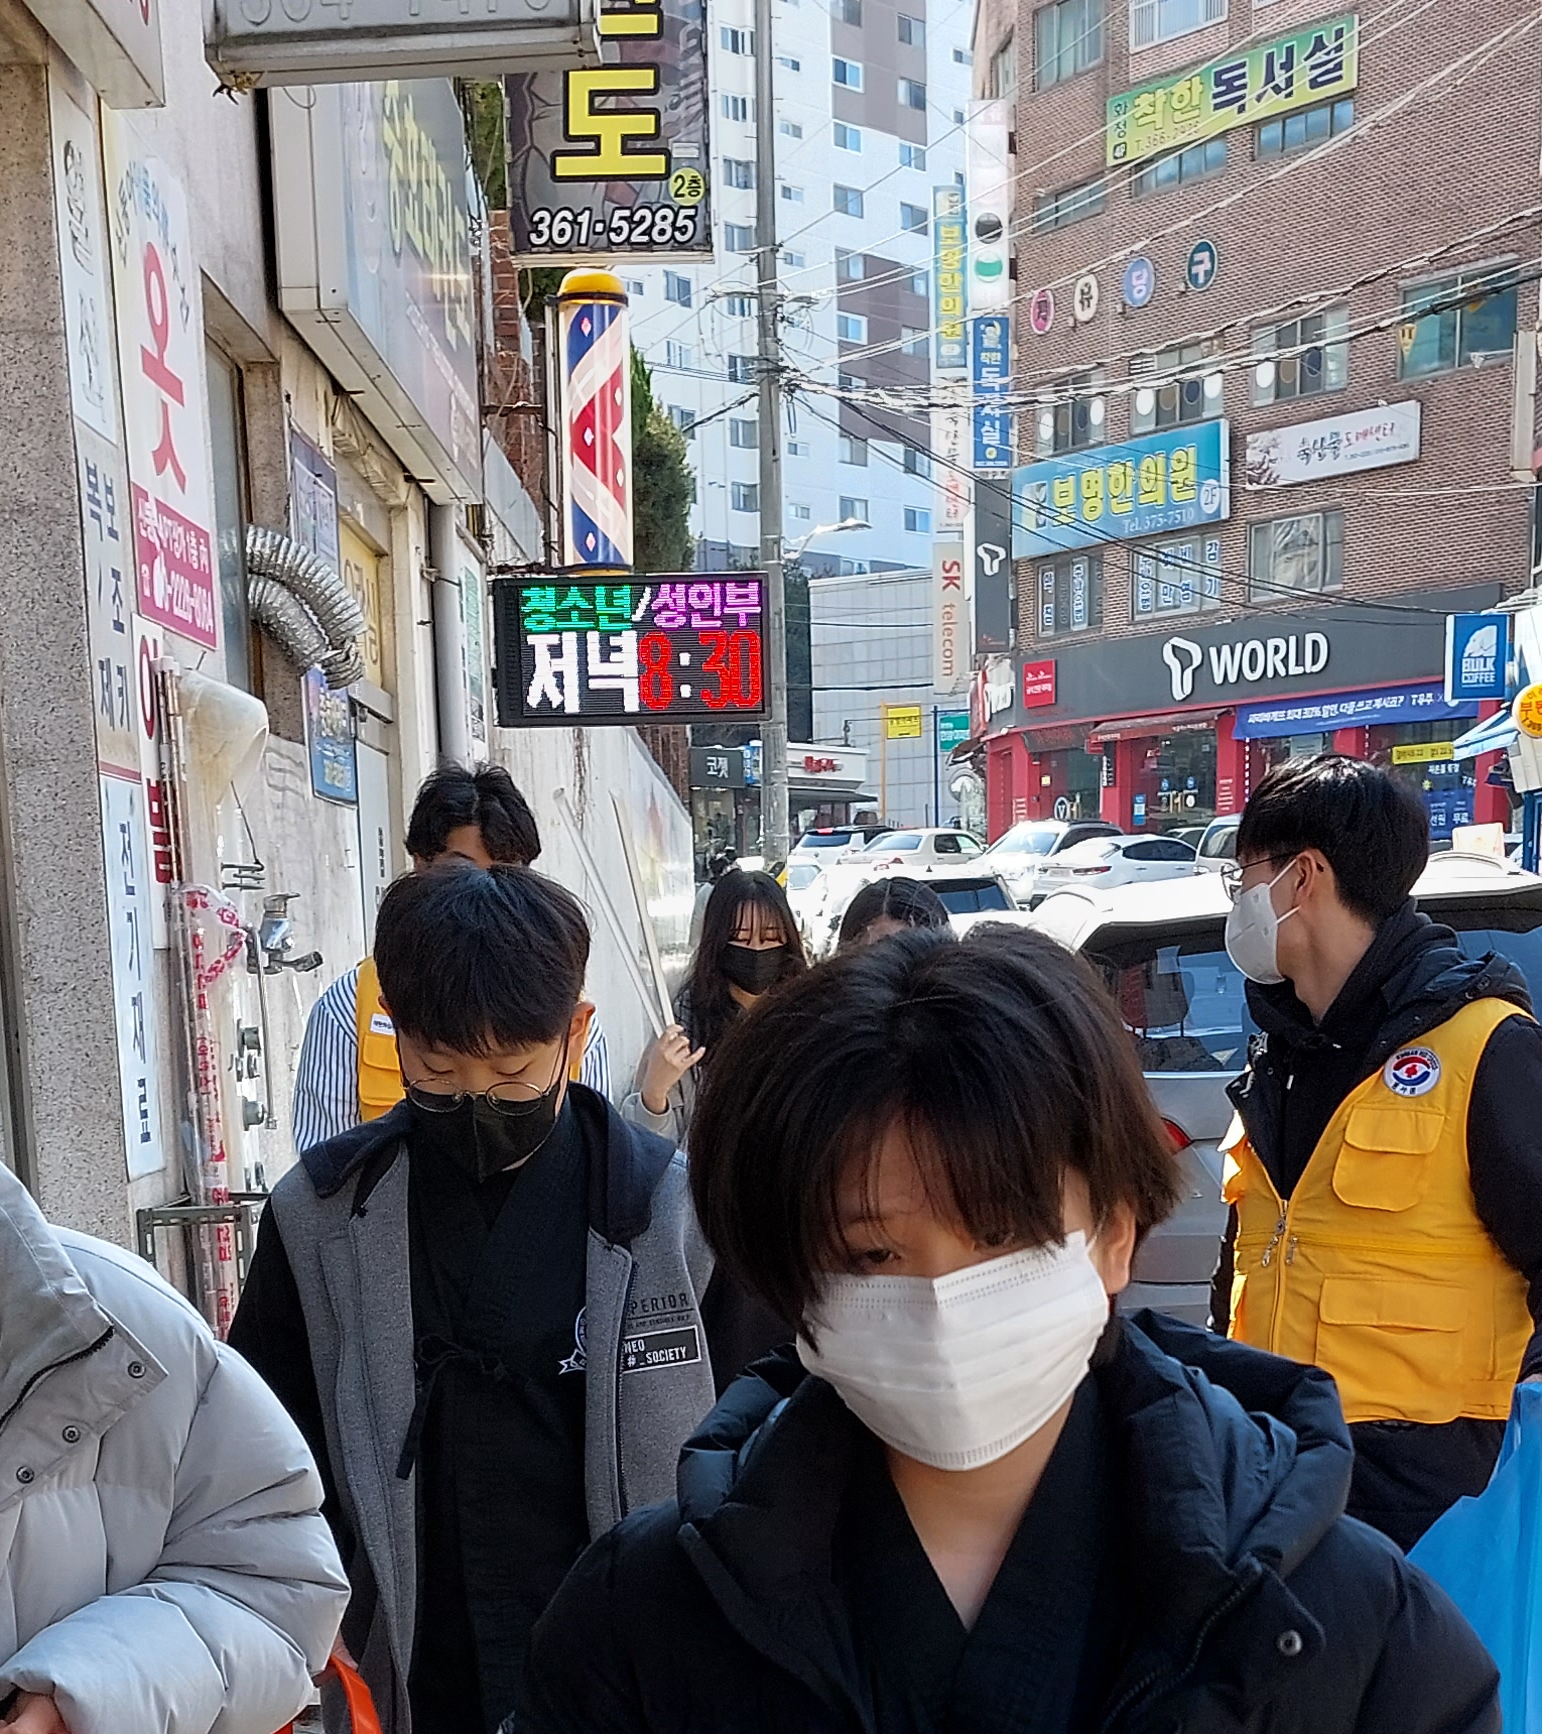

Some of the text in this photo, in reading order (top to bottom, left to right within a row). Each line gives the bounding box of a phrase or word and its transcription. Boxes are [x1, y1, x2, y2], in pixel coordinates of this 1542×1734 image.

[1209, 26, 1346, 115] 독서실
[941, 559, 961, 591] SK
[525, 630, 762, 714] 저녁 8:30
[941, 603, 960, 677] telecom
[1209, 631, 1329, 686] WORLD
[1461, 656, 1496, 673] BULK
[1461, 672, 1496, 684] COFFEE
[118, 820, 151, 1146] 전기재료
